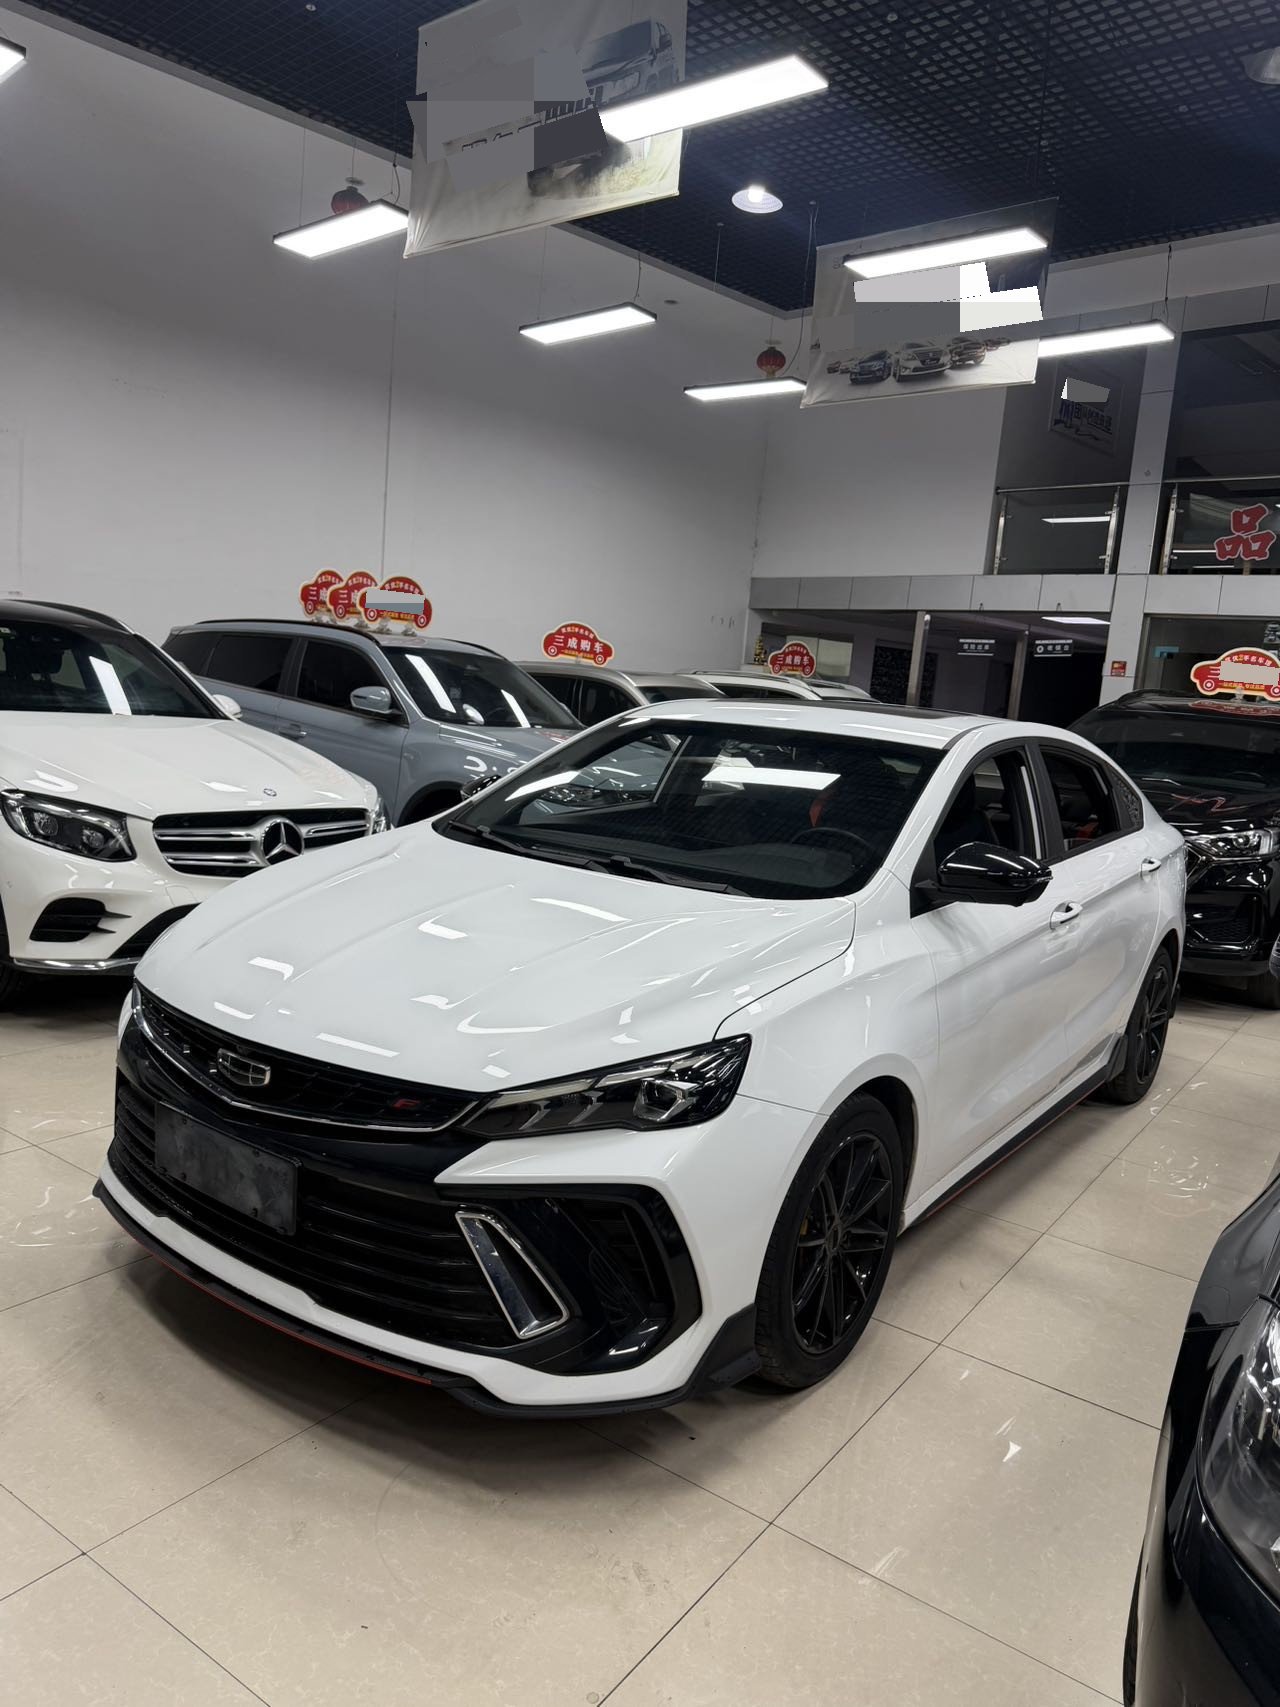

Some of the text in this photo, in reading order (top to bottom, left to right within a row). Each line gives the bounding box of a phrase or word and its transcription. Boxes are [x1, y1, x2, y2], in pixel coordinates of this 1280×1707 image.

[1214, 503, 1276, 560] 品
[553, 635, 604, 653] 三成购车
